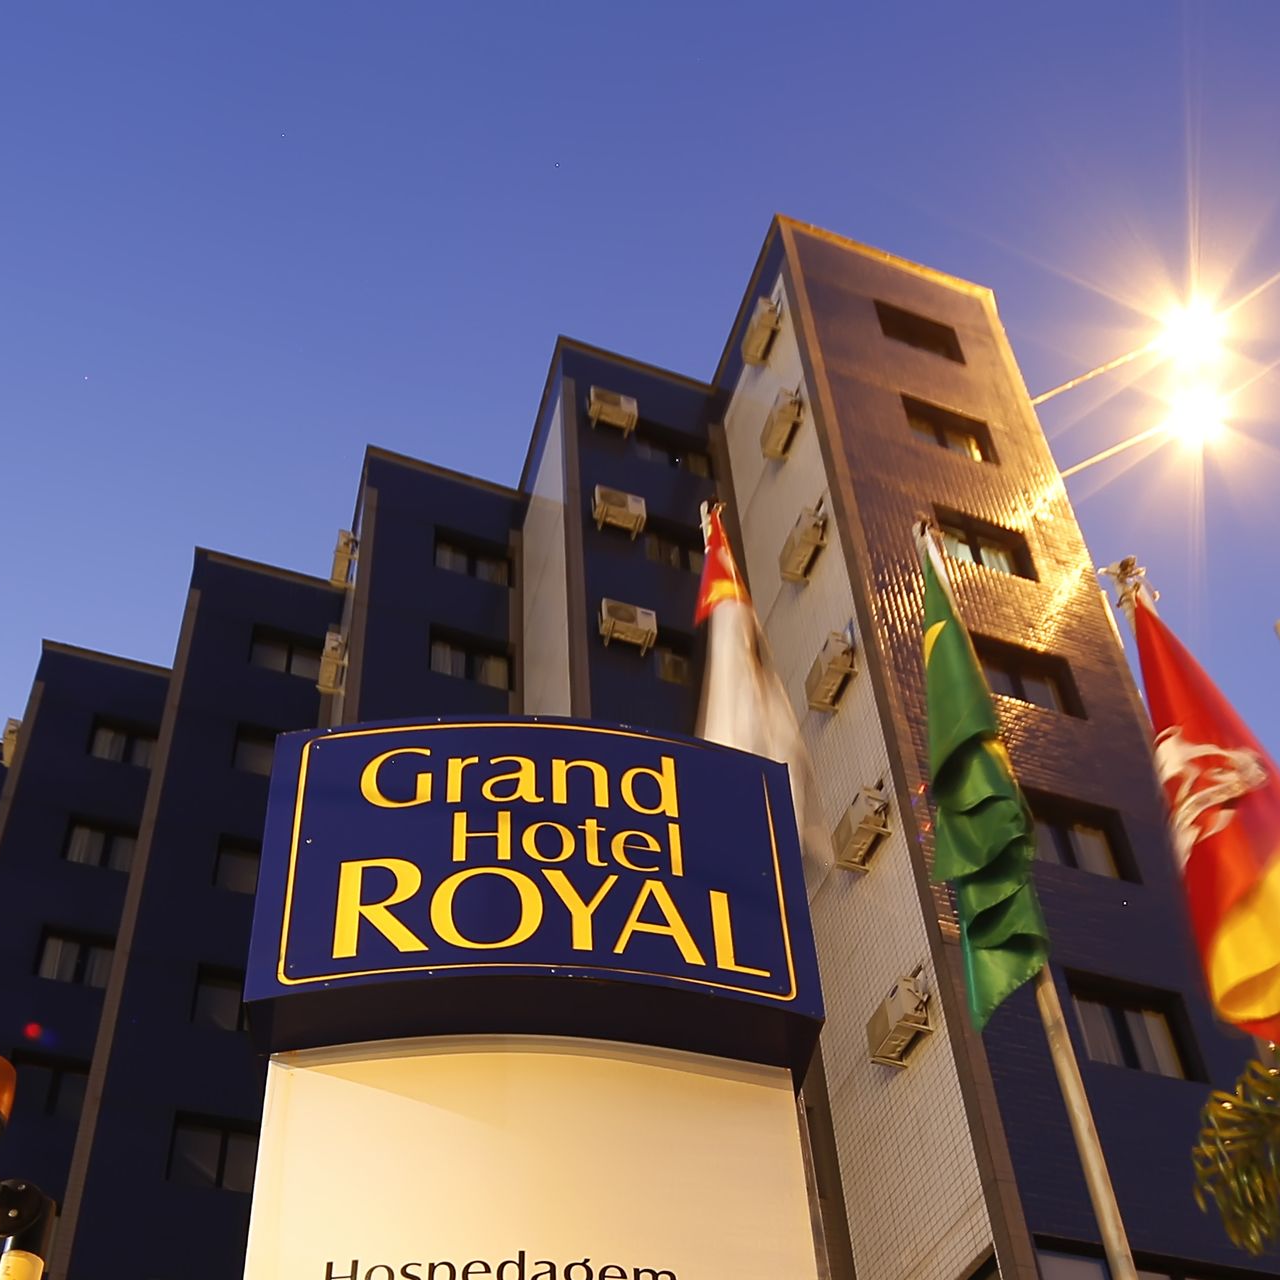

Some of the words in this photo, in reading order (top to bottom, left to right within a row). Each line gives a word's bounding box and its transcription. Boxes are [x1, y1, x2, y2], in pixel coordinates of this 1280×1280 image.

[360, 747, 679, 818] Grand
[452, 810, 684, 877] Hotel
[331, 857, 772, 978] ROYAL
